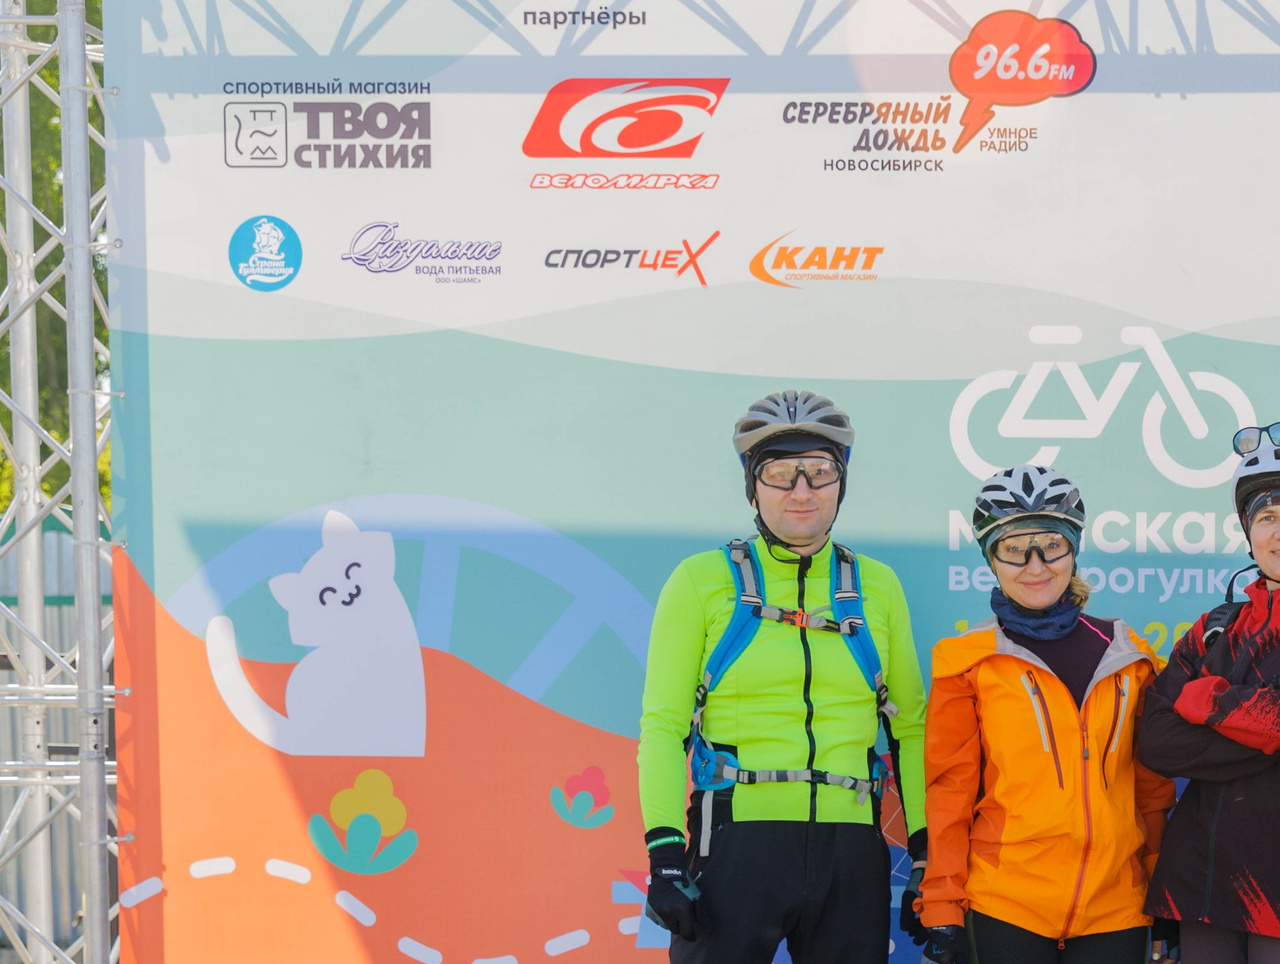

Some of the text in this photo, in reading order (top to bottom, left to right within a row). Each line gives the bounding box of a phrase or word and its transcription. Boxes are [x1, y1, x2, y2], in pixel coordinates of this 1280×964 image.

[522, 7, 647, 30] партнёры
[223, 78, 431, 98] спортивный магазин
[781, 95, 952, 125] СЕРЕБРЯНЫЙ
[293, 101, 432, 140] ТВОЯ
[852, 128, 947, 153] ДОЖДЬ
[987, 127, 1038, 140] УМНОЕ
[293, 143, 432, 169] СТИХИЯ
[979, 140, 1029, 154] РАДИО
[823, 159, 944, 172] НОВОСИБИРСК
[529, 173, 721, 190] ВЕЛОМАРКА
[341, 221, 503, 274] Раздольное
[248, 258, 285, 269] Страна
[770, 246, 885, 271] КАНТ
[415, 265, 502, 276] ВОДА ПИТЬЕВАЯ
[784, 272, 878, 281] СПОРТИВНЫЙ МАГАЗИН
